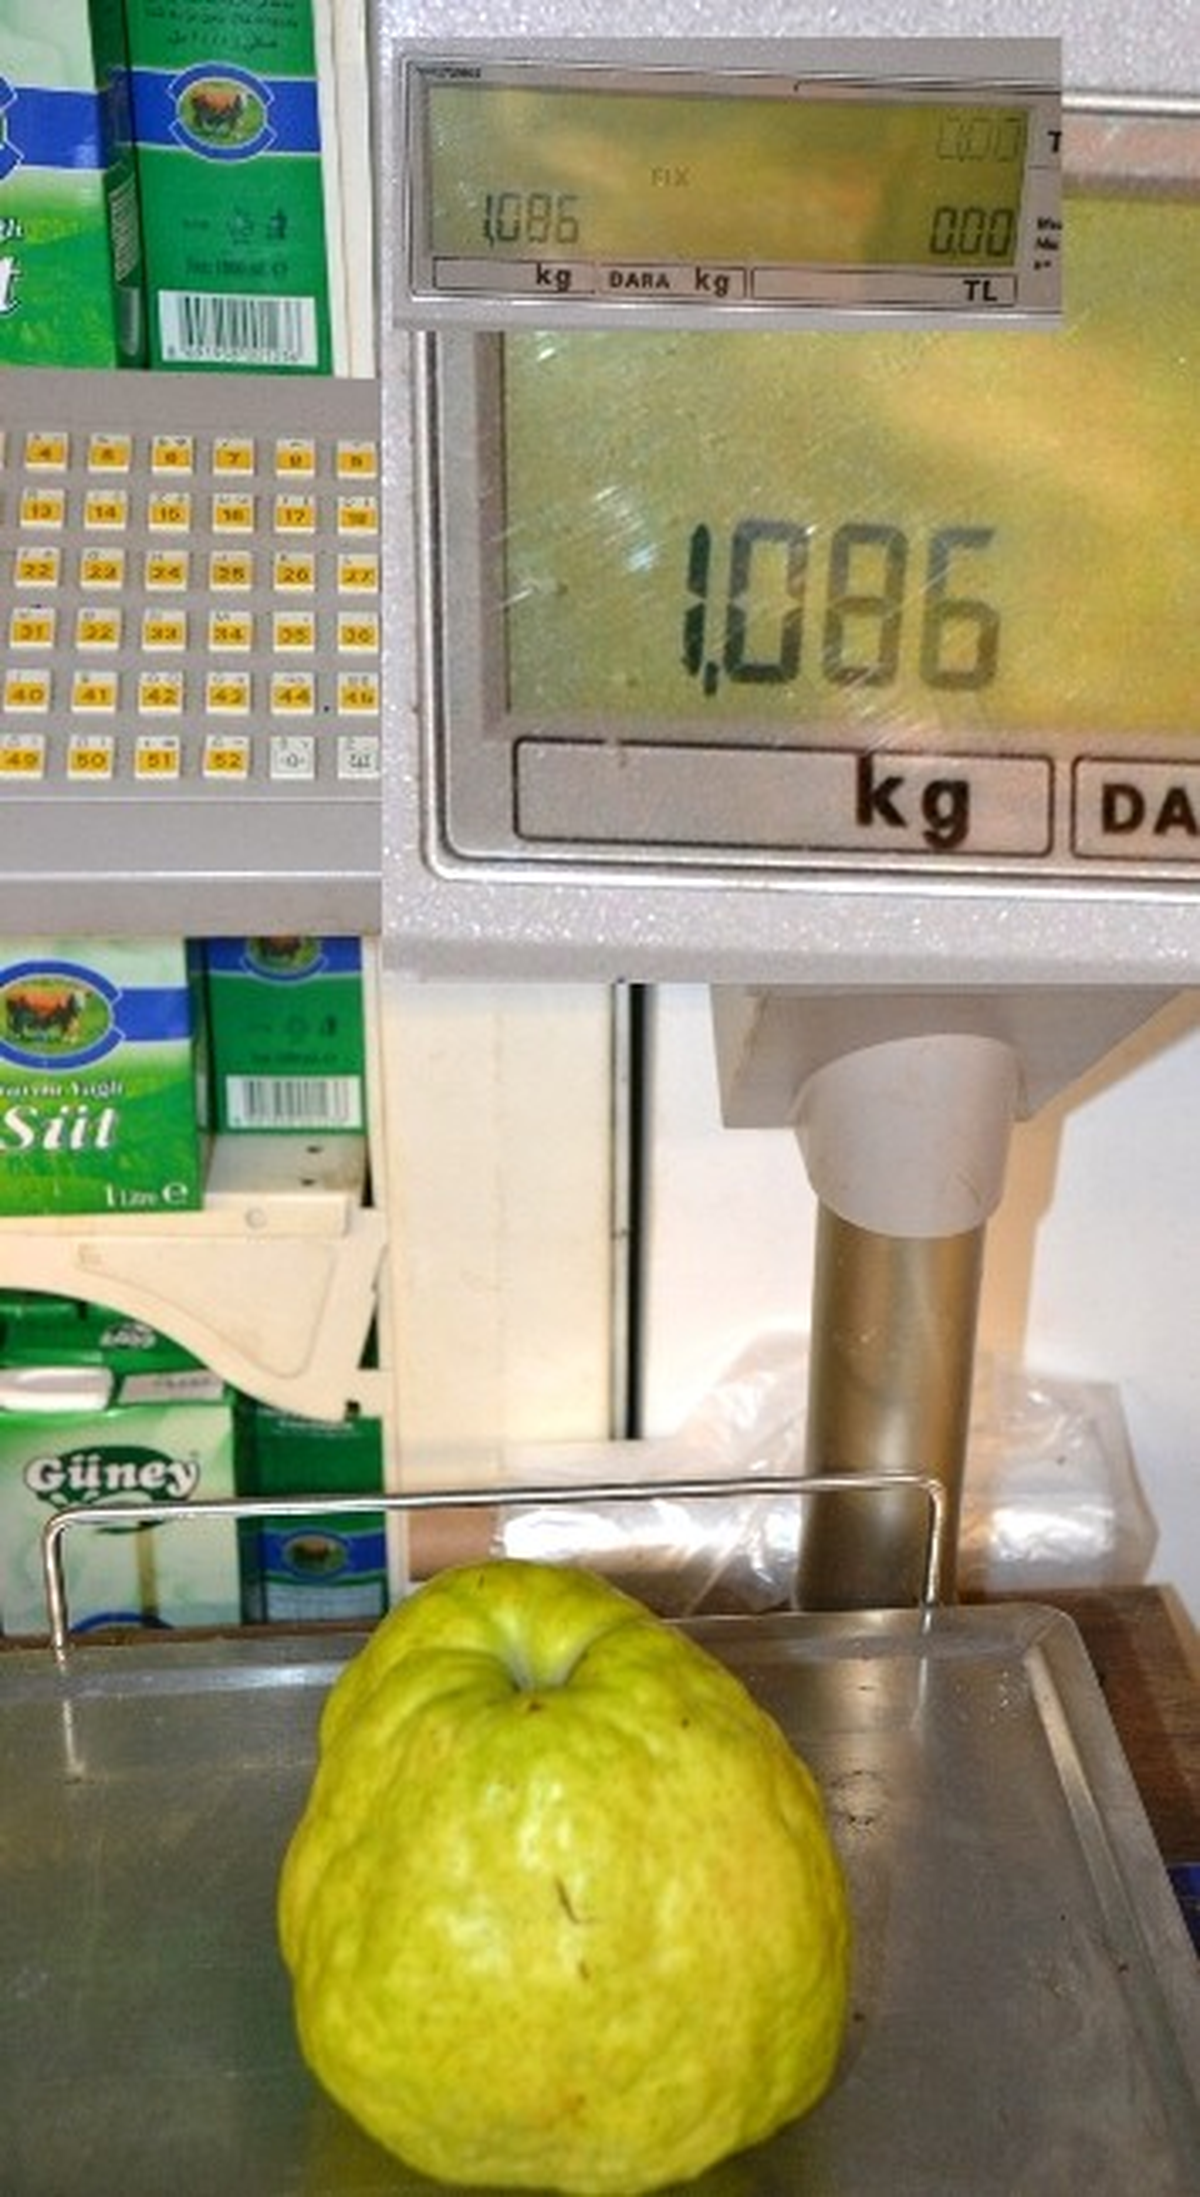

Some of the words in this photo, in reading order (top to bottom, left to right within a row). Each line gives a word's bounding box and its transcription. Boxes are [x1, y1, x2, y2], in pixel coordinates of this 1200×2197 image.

[651, 167, 691, 187] FIX
[536, 262, 571, 292] kg
[609, 270, 670, 289] DARA
[695, 266, 730, 298] kg
[963, 279, 998, 301] TL
[32, 504, 51, 517] 13
[96, 506, 116, 519] 14
[161, 507, 180, 521] 15
[286, 510, 305, 522] 17
[25, 564, 51, 577] 22
[153, 566, 180, 579] 24
[219, 567, 244, 581] 25
[284, 568, 309, 582] 26
[347, 570, 372, 583] 27
[681, 519, 999, 695] 1,086
[21, 626, 43, 639] 31
[215, 626, 243, 640] 34
[12, 689, 44, 701] 40
[83, 689, 107, 701] 41
[148, 689, 178, 704] 42
[279, 690, 312, 703] 44
[7, 753, 38, 767] 49
[77, 753, 106, 768] 50
[148, 754, 171, 768] 51
[215, 753, 241, 768] 52
[854, 754, 970, 849] kg
[0, 1105, 118, 1151] Süt
[25, 1452, 199, 1498] Güney
